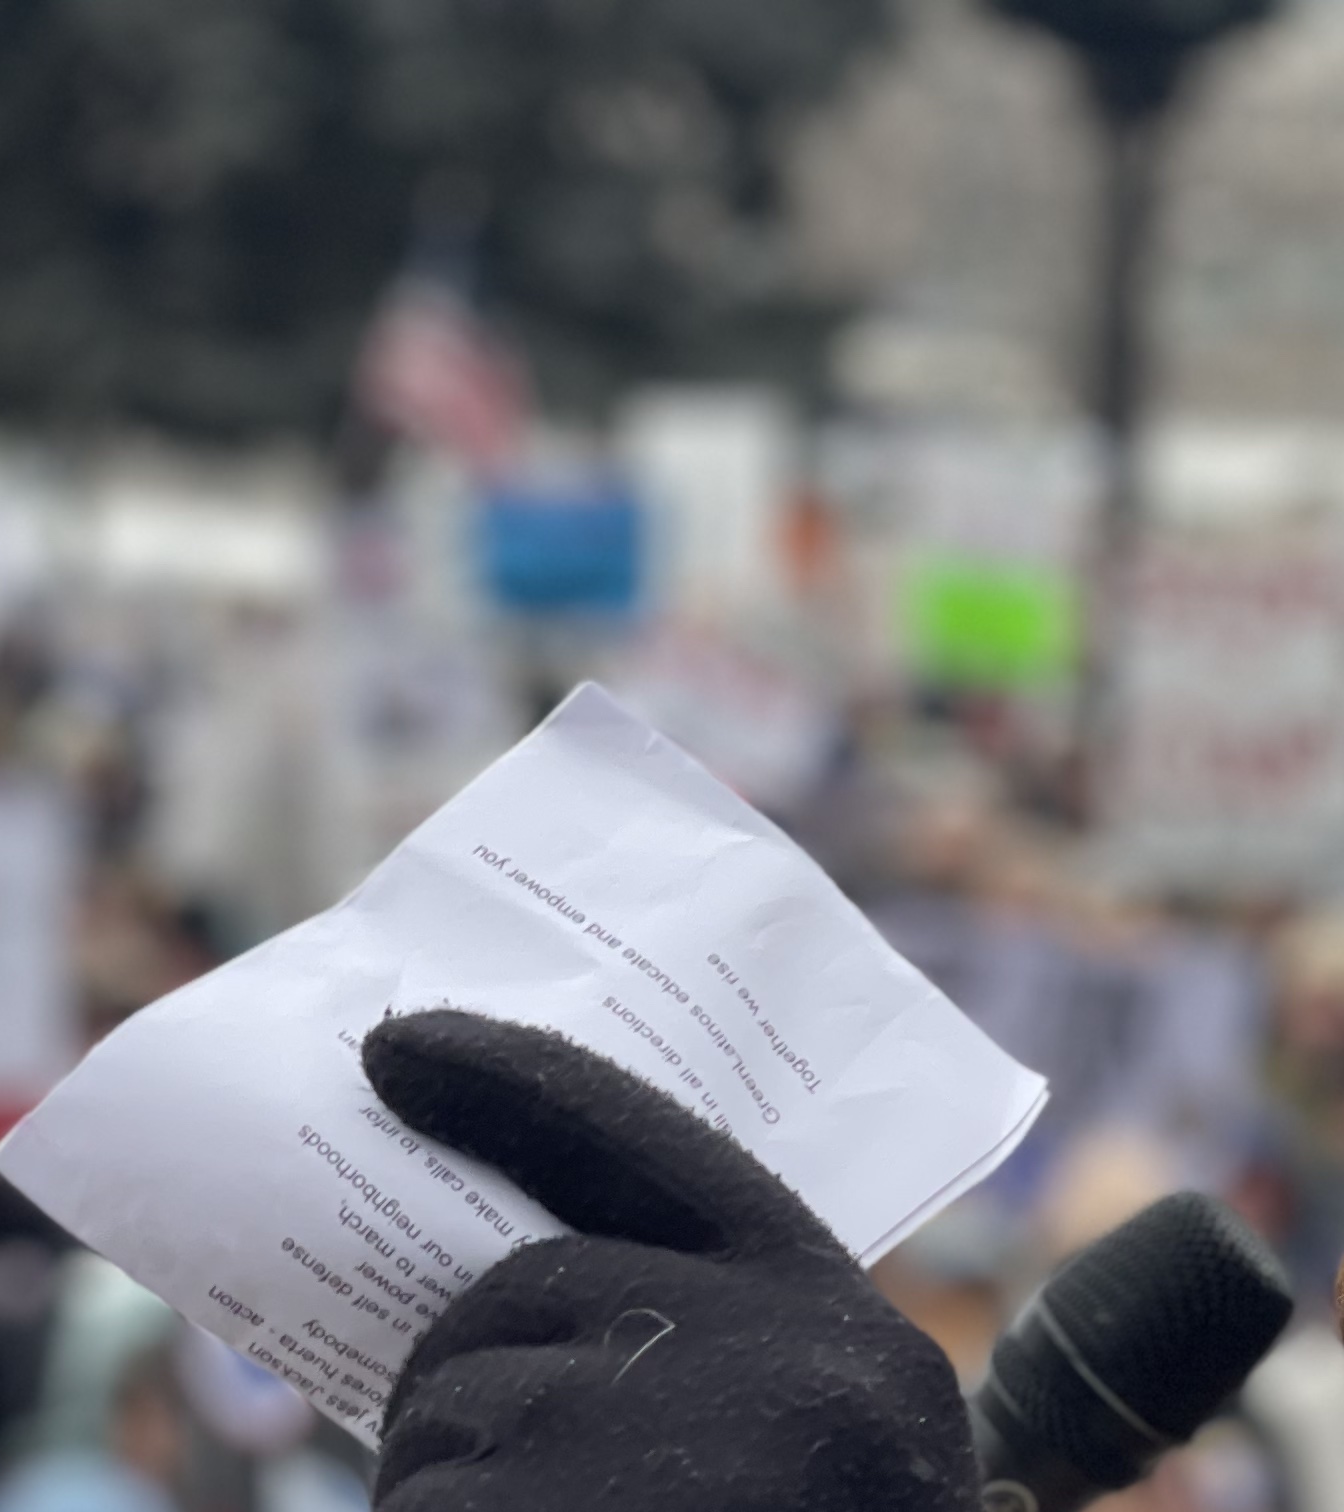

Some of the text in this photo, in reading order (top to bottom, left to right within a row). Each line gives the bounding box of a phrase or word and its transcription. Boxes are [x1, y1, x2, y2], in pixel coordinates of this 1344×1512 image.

[472, 844, 781, 1125] GreenLatinos educate and empower you
[602, 996, 682, 1066] directions
[707, 953, 822, 1095] Together we rise
[678, 1067, 703, 1089] all
[701, 1091, 718, 1113] in
[399, 1136, 420, 1155] to
[424, 1150, 465, 1192] calls,
[297, 1125, 474, 1286] in our neighborhoods
[464, 1190, 514, 1237] make
[339, 1199, 452, 1301] wer to march,
[209, 1285, 265, 1326] action
[281, 1237, 412, 1333] in self defense
[354, 1261, 416, 1305] power
[248, 1342, 325, 1396] Jackson
[279, 1334, 339, 1379] huerta
[302, 1319, 399, 1382] somebody
[341, 1373, 387, 1407] lores
